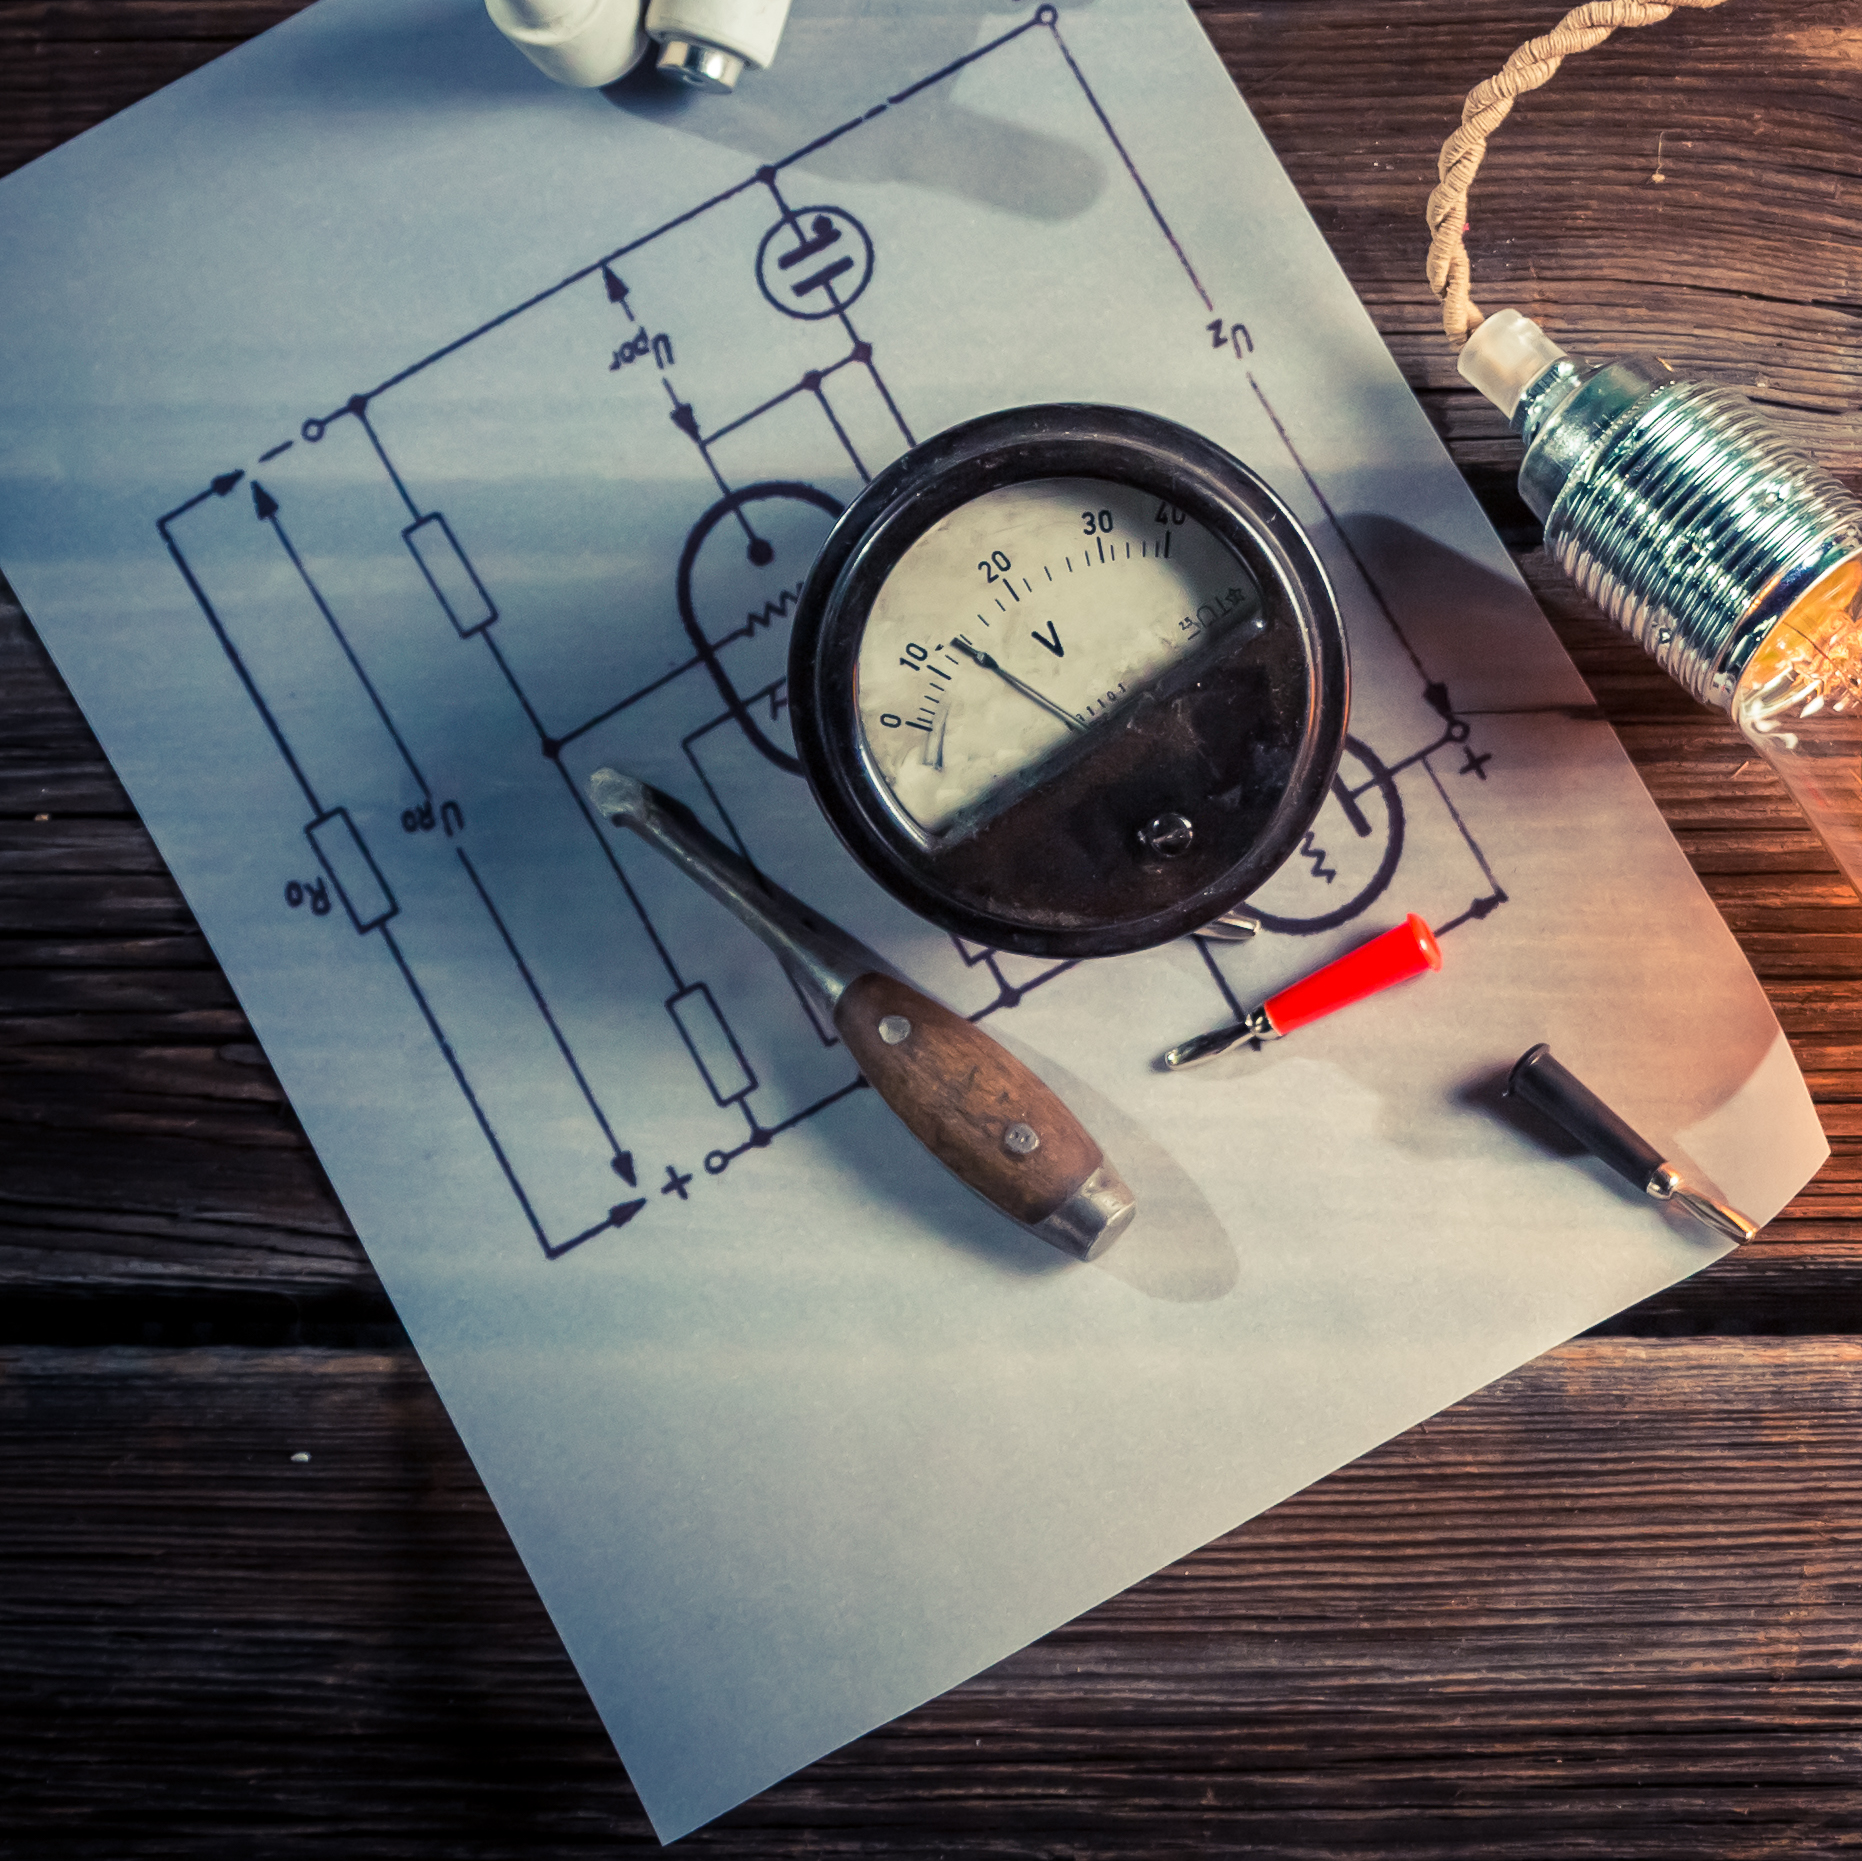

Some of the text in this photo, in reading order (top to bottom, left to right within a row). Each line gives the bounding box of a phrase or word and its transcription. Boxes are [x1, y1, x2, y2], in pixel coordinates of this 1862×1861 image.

[1080, 509, 1115, 536] 30
[977, 549, 1014, 584] 20
[1030, 619, 1066, 658] V
[897, 640, 930, 674] 10
[878, 710, 903, 731] 0
